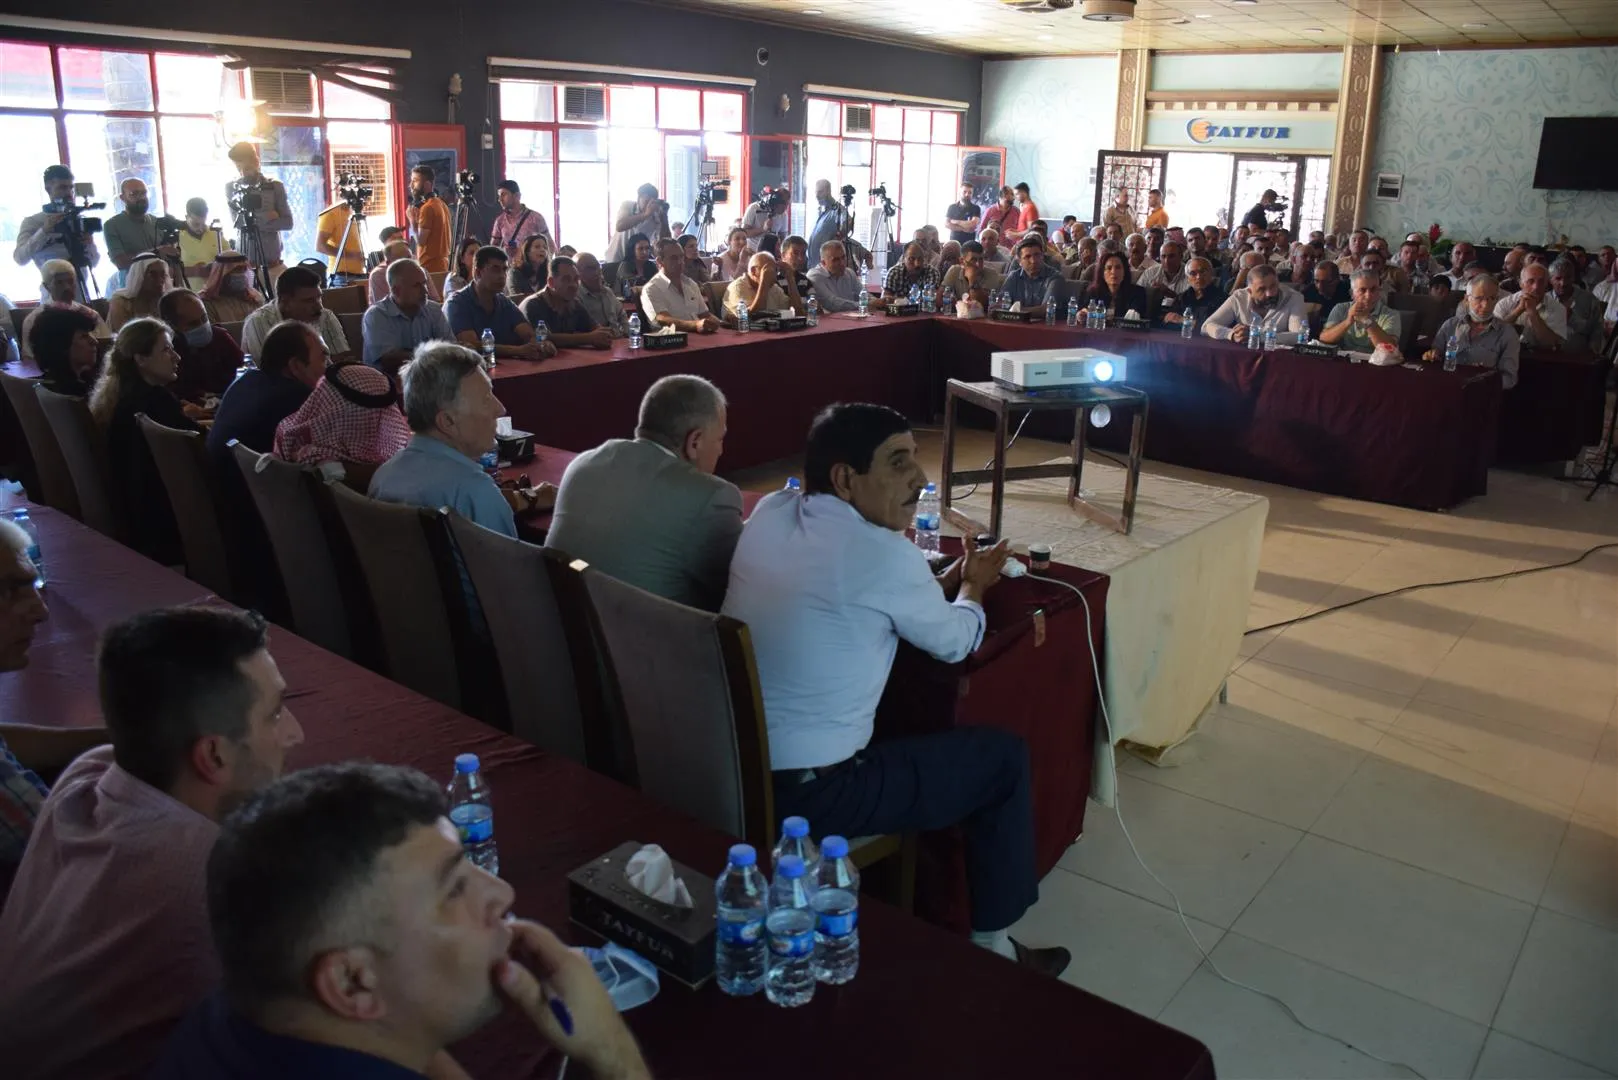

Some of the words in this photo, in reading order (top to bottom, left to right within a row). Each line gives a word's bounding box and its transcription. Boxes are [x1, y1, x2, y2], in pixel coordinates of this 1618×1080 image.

[1206, 125, 1290, 139] TAYFUR
[516, 439, 526, 456] 7
[601, 910, 674, 960] TAYFUR
